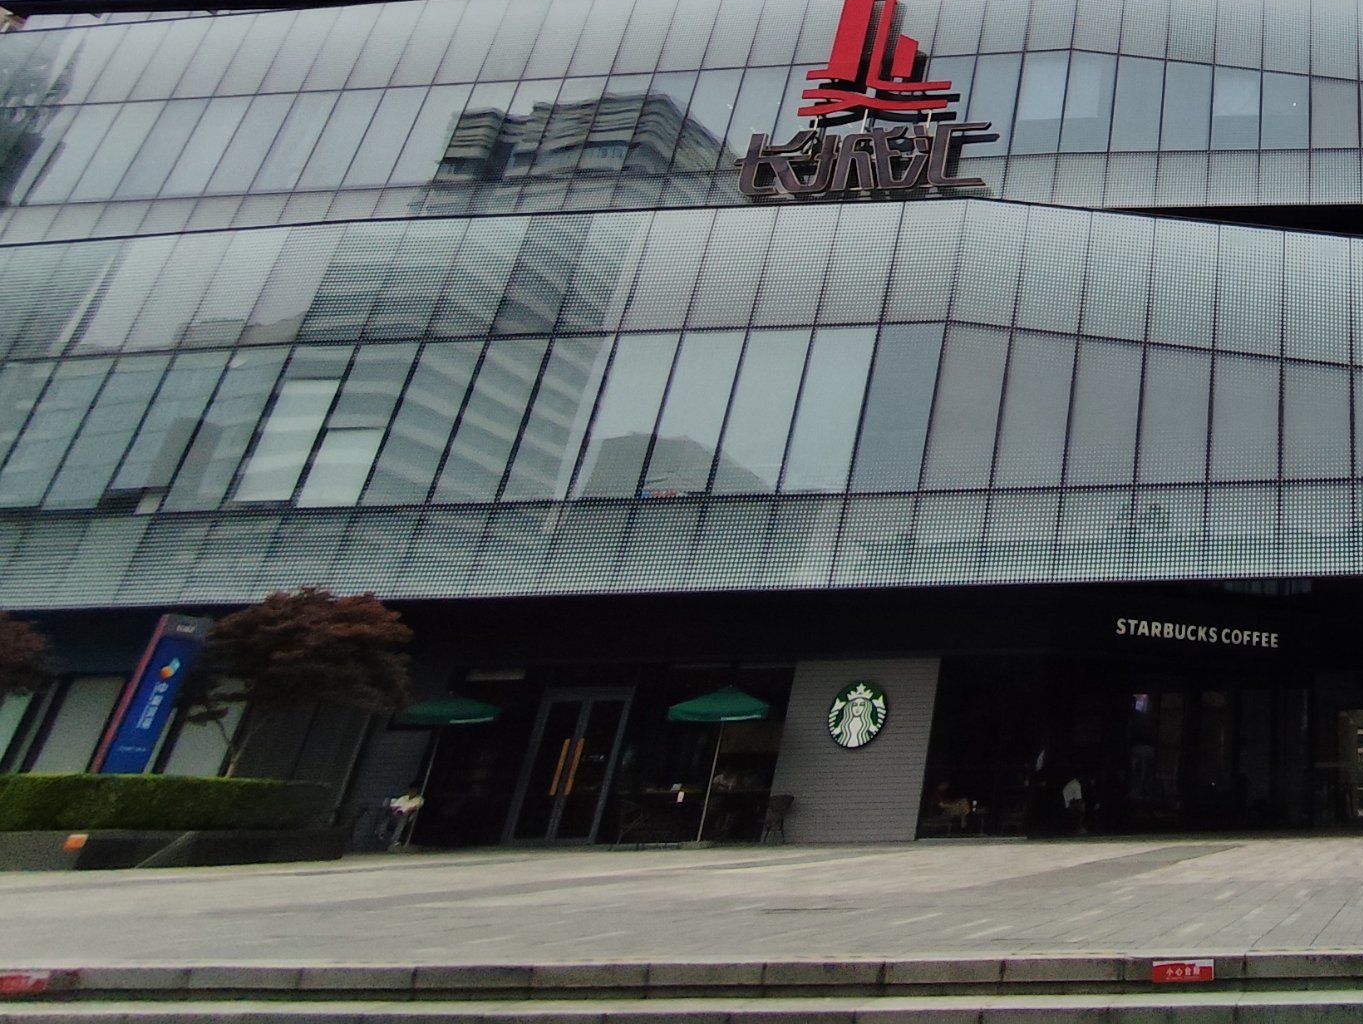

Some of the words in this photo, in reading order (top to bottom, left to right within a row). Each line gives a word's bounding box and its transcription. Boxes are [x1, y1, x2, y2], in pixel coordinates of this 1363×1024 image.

[736, 121, 993, 196] 长城汇
[1116, 618, 1218, 643] STARBUCKS
[1221, 628, 1279, 648] COFFEE
